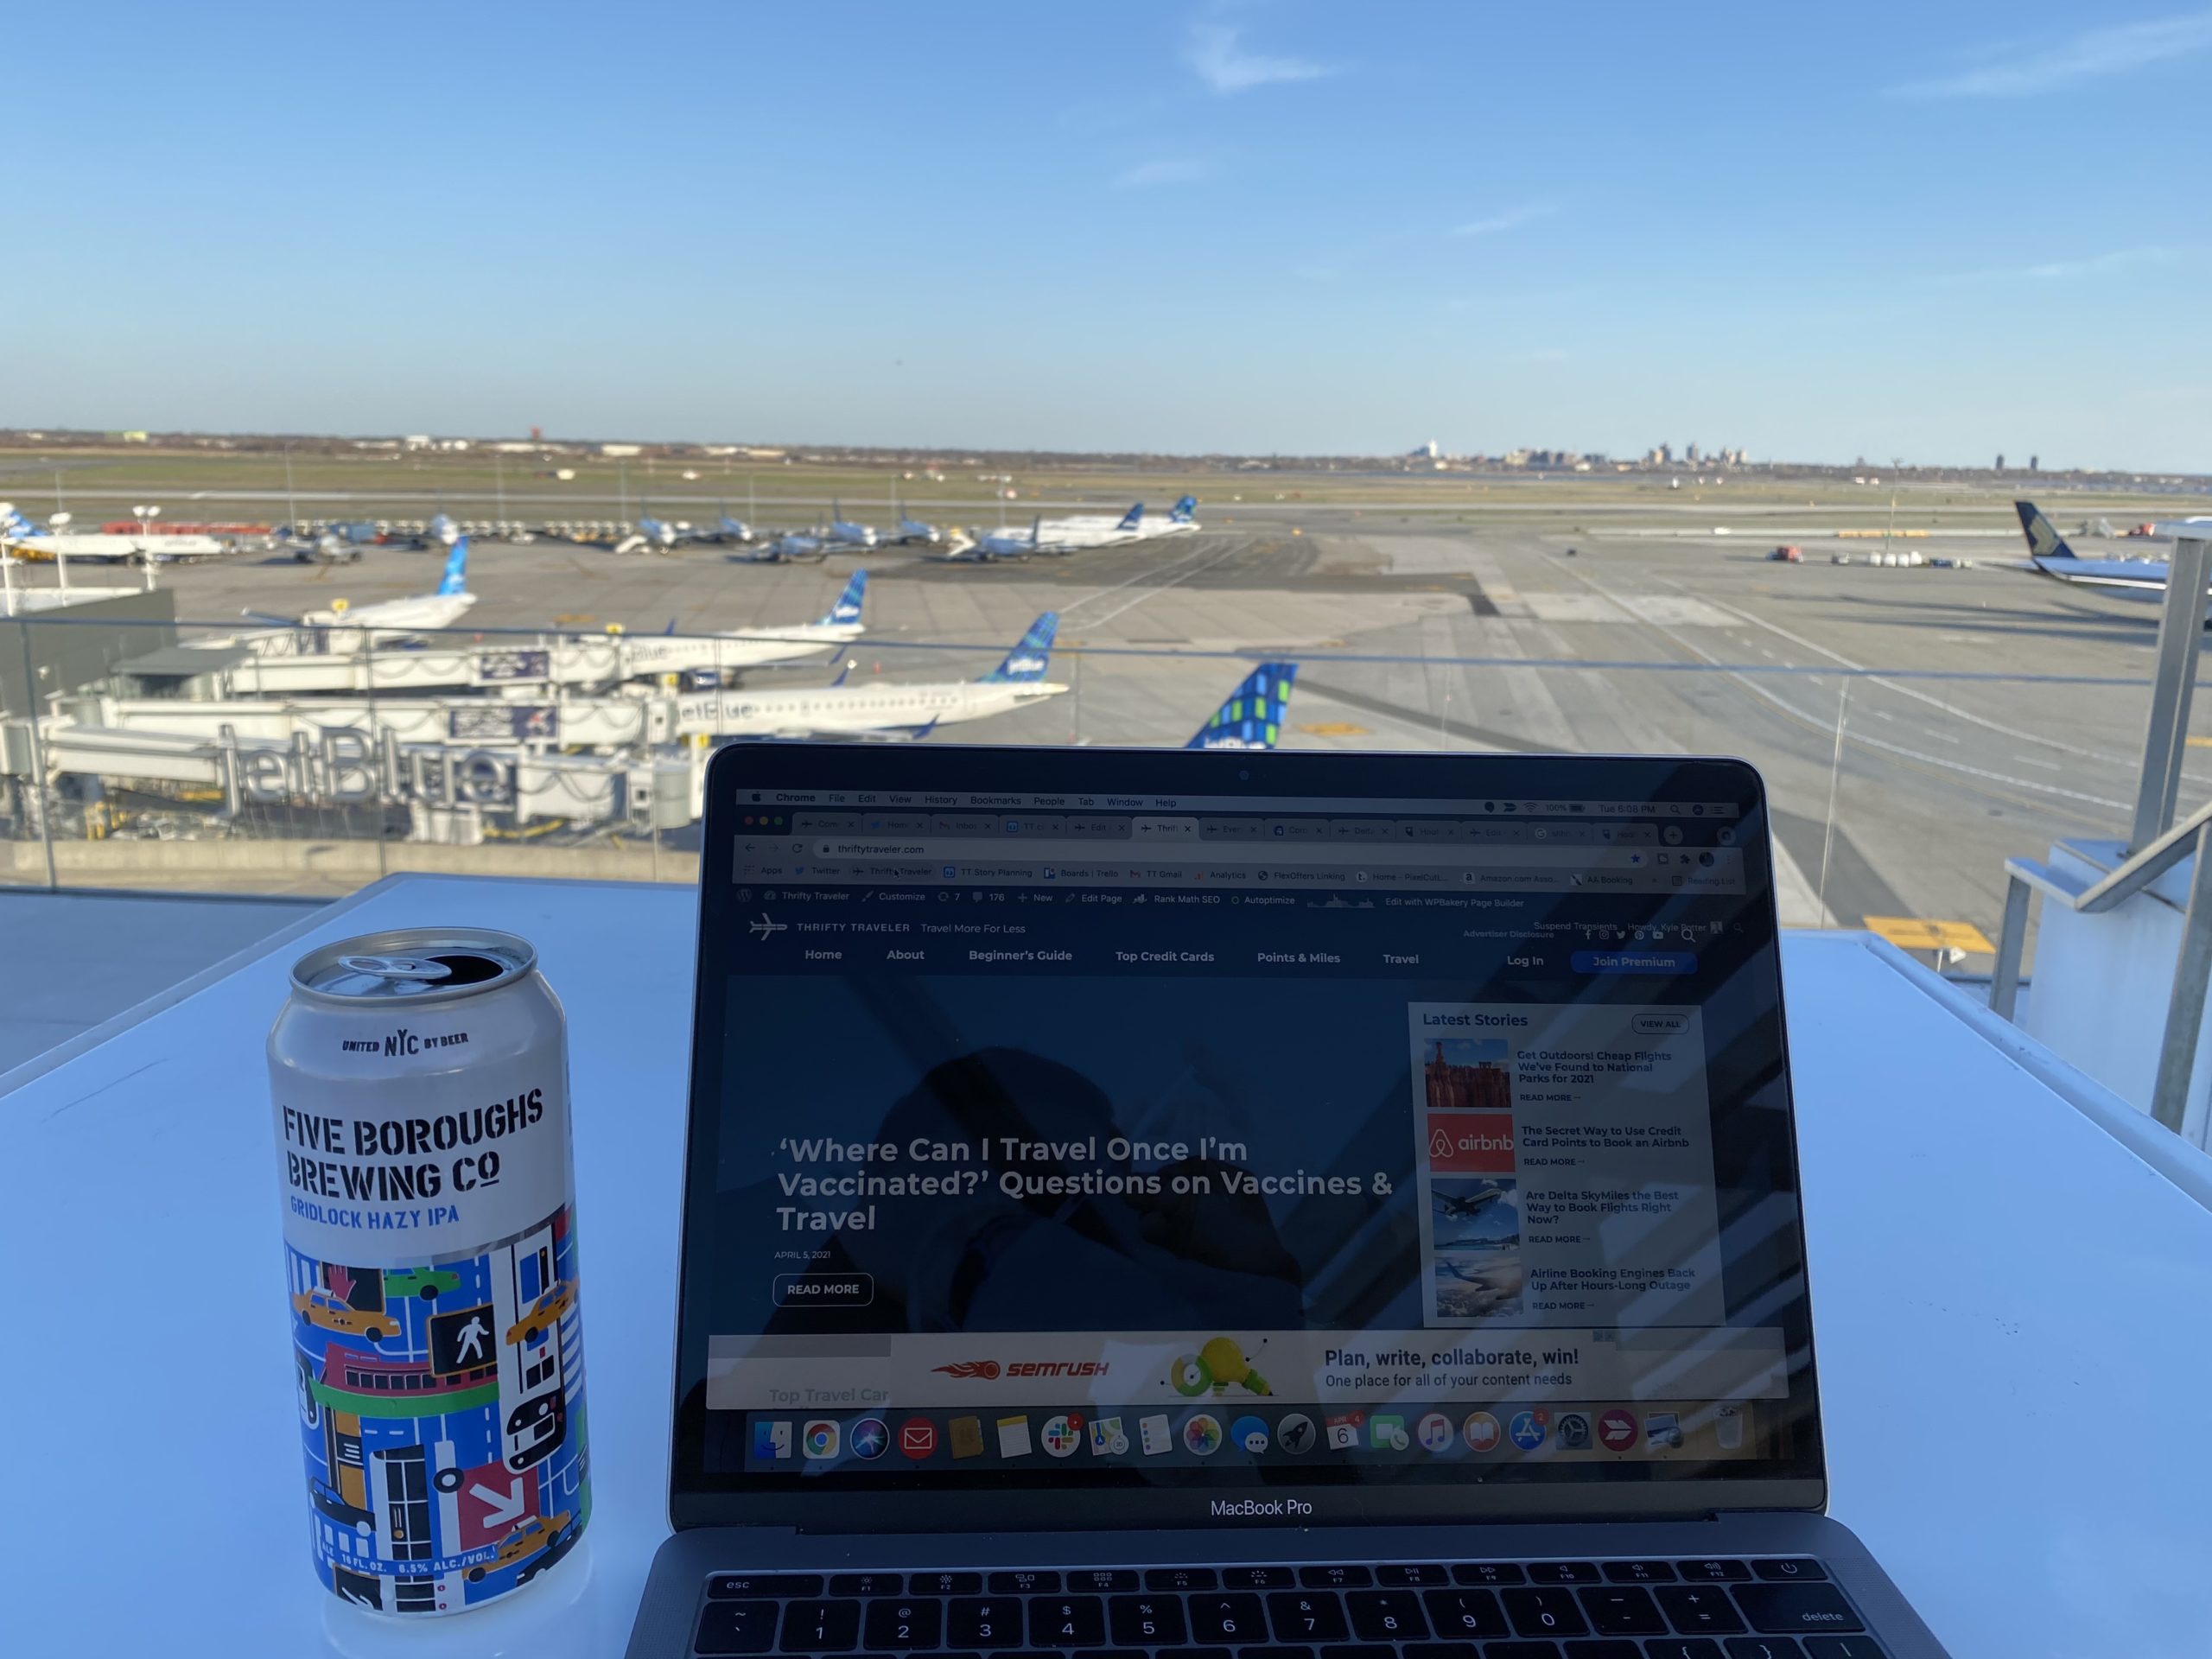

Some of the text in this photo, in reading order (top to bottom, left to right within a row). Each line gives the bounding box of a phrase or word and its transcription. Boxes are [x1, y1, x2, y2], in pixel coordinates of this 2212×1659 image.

[776, 793, 816, 802] Chrome
[889, 795, 912, 804] View
[925, 796, 957, 805] History
[970, 796, 1021, 806] Bookmarks
[1034, 798, 1065, 806] People
[1107, 798, 1143, 807] Window
[1155, 799, 1176, 808] Help
[1599, 804, 1615, 813] Tue
[838, 845, 924, 855] thriftytraveler.com
[782, 891, 850, 901] Thrifty Traveler
[879, 893, 925, 901] Customize
[1033, 893, 1053, 902] New
[1082, 894, 1122, 905] Edit Page
[1154, 895, 1220, 904] Rank Math SEO
[1244, 896, 1295, 906] Autoptimize
[1385, 898, 1524, 908] Edit with WPBakery Page Builder
[797, 923, 910, 931] THRIFTY TRAVELER
[921, 924, 950, 933] Travel
[954, 925, 981, 933] More
[984, 925, 1001, 933] For
[805, 950, 842, 959] Home
[887, 950, 925, 960] About
[1037, 950, 1073, 961] Guide
[1116, 951, 1215, 963] Top Credit Cards
[1258, 953, 1340, 963] Points & Miles
[1383, 954, 1419, 964] Travel
[1508, 956, 1544, 967] Log In
[1592, 957, 1675, 968] Join Premium
[1423, 1014, 1528, 1027] Latest Stories
[342, 1029, 468, 1057] UNITED NYC BY BEER
[1517, 1051, 1671, 1063] Get Outdoors! Cheap Flights
[1554, 1062, 1589, 1072] Found
[1592, 1063, 1605, 1072] to
[1607, 1062, 1653, 1072] National
[1519, 1074, 1594, 1084] Parks for 2021
[283, 1104, 346, 1155] FIVE
[353, 1088, 543, 1156] BOROUGHS
[1522, 1126, 1681, 1138] The Secret Way to Use Credit
[1458, 1134, 1515, 1151] airbnb
[1522, 1138, 1548, 1147] Card
[1552, 1138, 1587, 1147] Points
[1589, 1139, 1601, 1147] to
[1604, 1138, 1633, 1147] Book
[1652, 1138, 1689, 1147] Airbnb
[908, 1138, 969, 1161] Can
[982, 1138, 988, 1160] I
[1000, 1137, 1096, 1160] Travel
[1107, 1137, 1192, 1161] Once
[287, 1150, 442, 1201] BREWING
[999, 1169, 1161, 1199] Questions
[1172, 1174, 1211, 1195] on
[1220, 1169, 1362, 1195] Vaccines
[1371, 1172, 1393, 1195] &
[1526, 1191, 1679, 1202] Are Delta SkyMiles the Best
[290, 1195, 459, 1230] GRIDLOCK HAZY IPA
[1527, 1203, 1671, 1214] Way to Book Flights Right
[776, 1206, 875, 1230] Travel
[1528, 1215, 1560, 1224] Now?
[1530, 1268, 1695, 1281] Airline Booking Engines Back
[788, 1284, 860, 1294] READ MORE
[1531, 1281, 1691, 1293] Up After Hours-Long Outage
[1325, 1348, 1579, 1369] Plan, write, collaborate, win!
[1325, 1373, 1572, 1389] One place for all of your content needs
[769, 1388, 889, 1404] Top Travel Car
[1211, 1499, 1312, 1516] MacBook Pro
[398, 1564, 428, 1573] 6.5%
[726, 1580, 750, 1589] esc
[1802, 1611, 1845, 1622] delete
